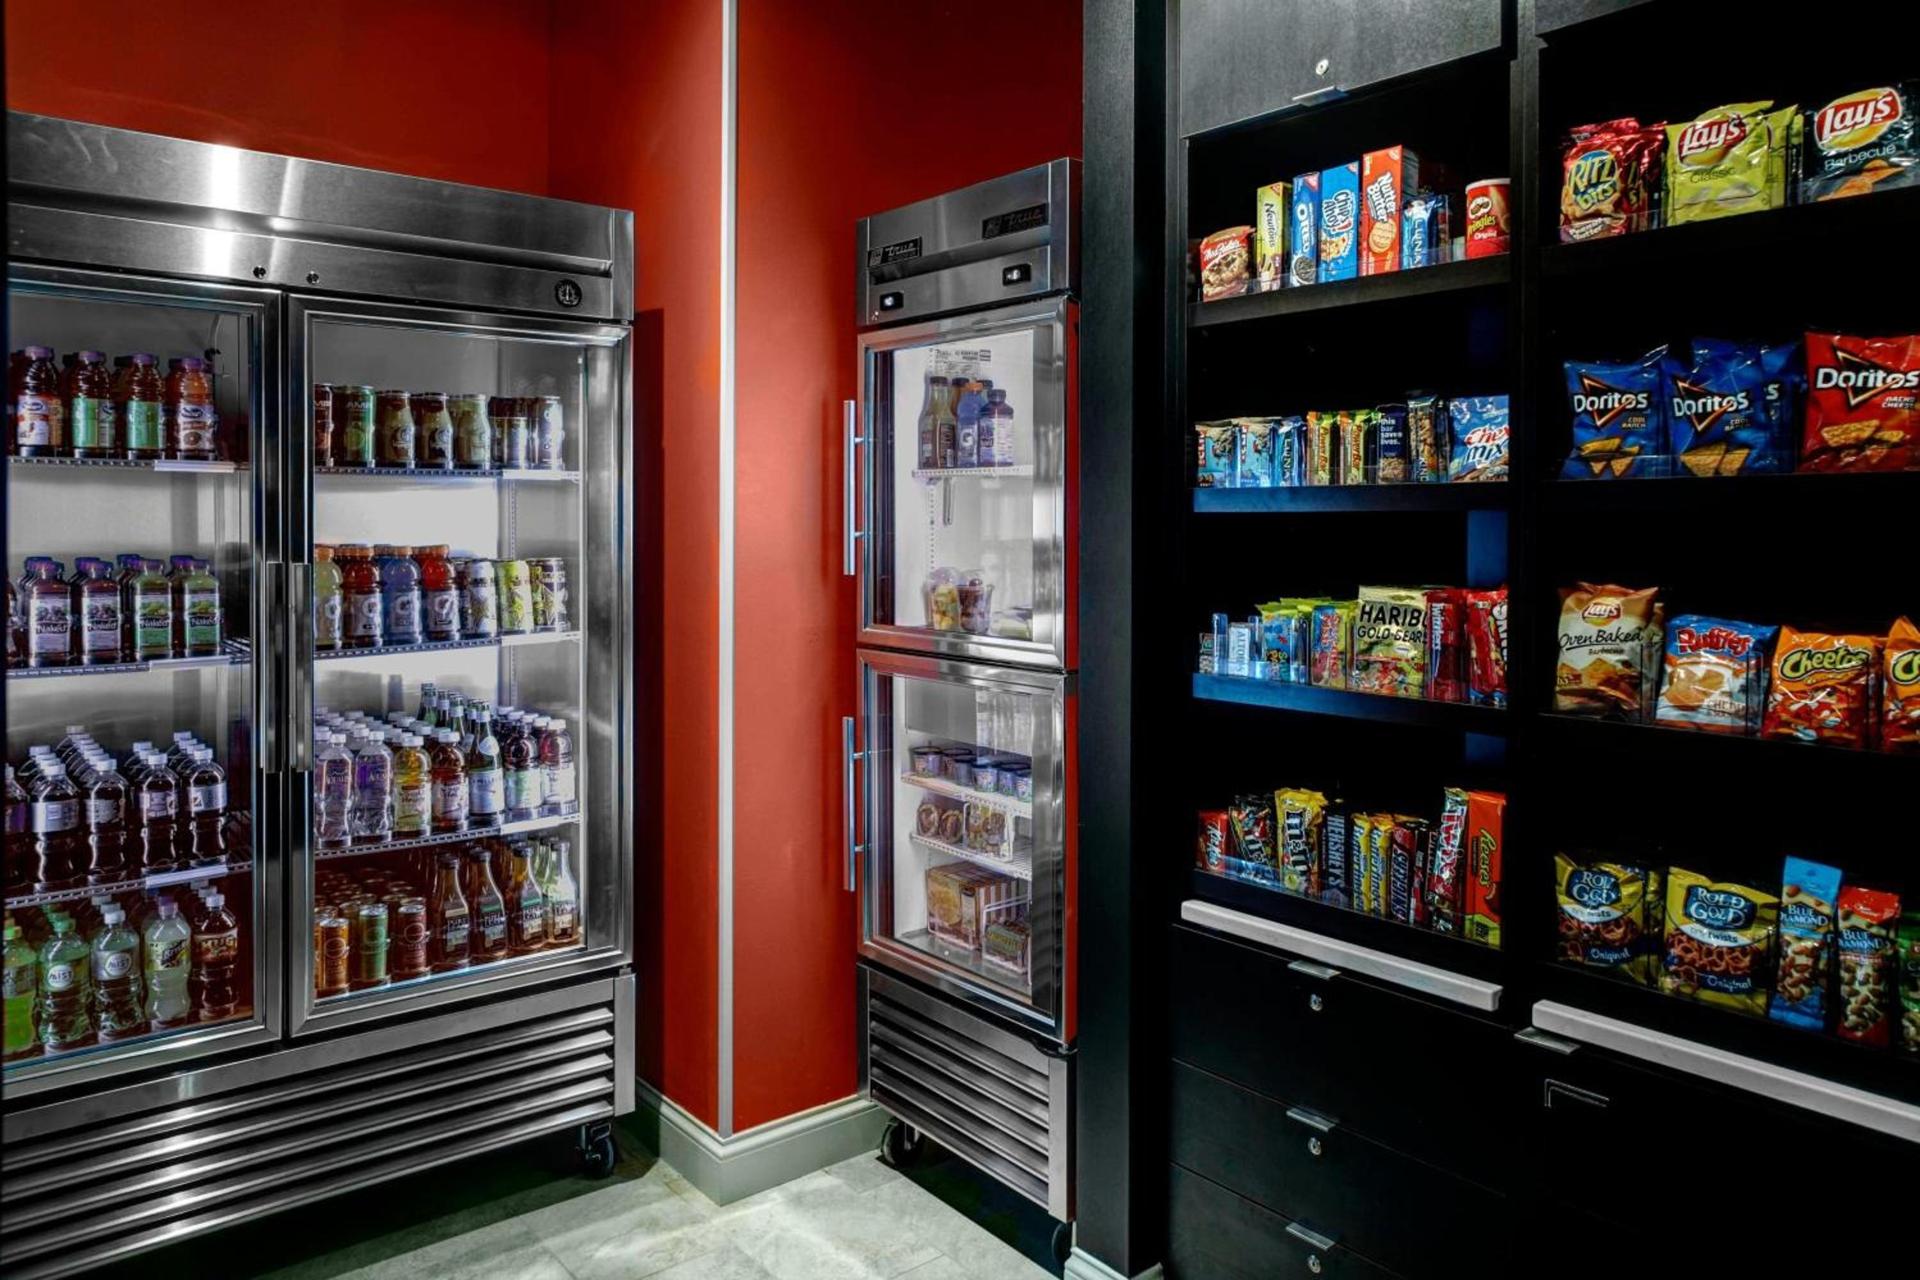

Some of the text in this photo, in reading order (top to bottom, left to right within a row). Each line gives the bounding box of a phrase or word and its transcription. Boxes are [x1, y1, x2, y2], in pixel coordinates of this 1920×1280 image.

[1818, 95, 1894, 143] Lay's
[1824, 143, 1897, 171] Barbecue
[1571, 156, 1615, 193] RITZ
[1690, 166, 1737, 184] Classic
[1334, 191, 1352, 224] Chips
[1377, 171, 1397, 216] Nutter
[1263, 202, 1276, 248] Newtons
[1297, 203, 1310, 252] OREO
[1413, 219, 1423, 265] LUNA
[1816, 367, 1920, 389] Doritos
[1573, 392, 1649, 413] Doritos
[1673, 392, 1749, 417] Doritos
[1283, 437, 1292, 480] LUNA
[1559, 626, 1644, 648] Oven Baked
[1677, 627, 1753, 656] Ruffles
[1781, 647, 1868, 679] Cheetos
[1480, 829, 1496, 886] Reese's
[1697, 888, 1746, 909] ROLD
[1788, 904, 1816, 917] BLUE
[1691, 901, 1745, 927] GOLD
[1590, 947, 1631, 963] Original
[1706, 975, 1753, 993] Original
